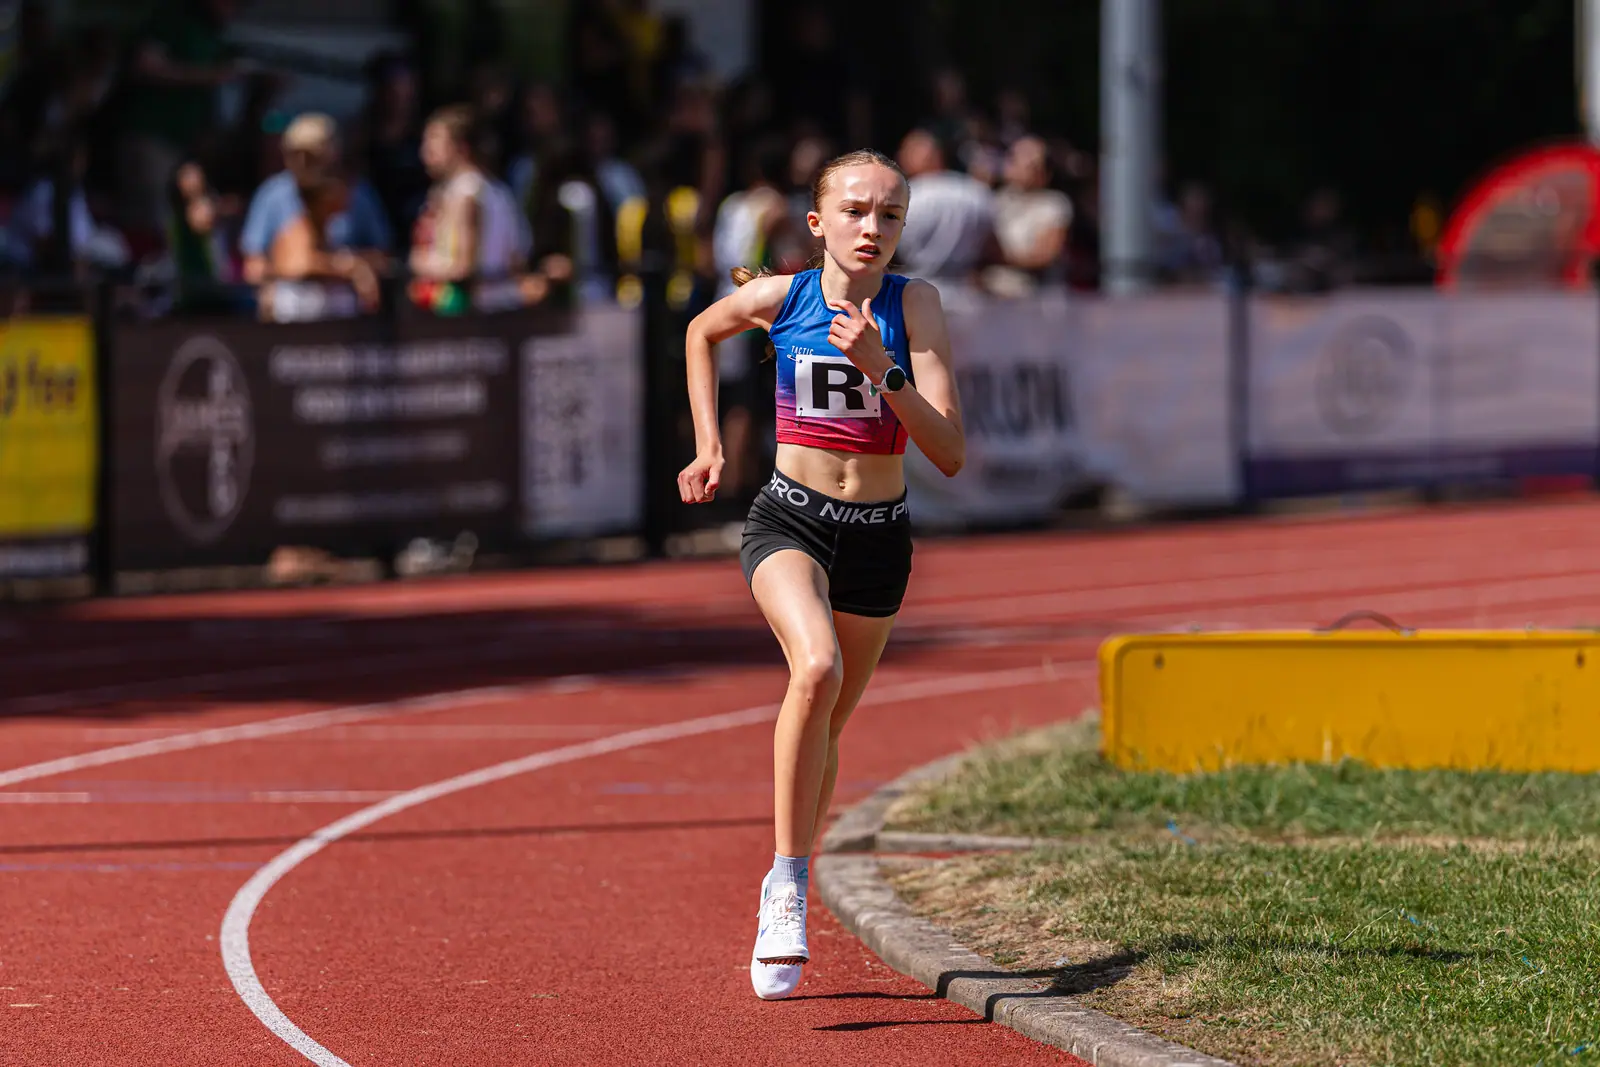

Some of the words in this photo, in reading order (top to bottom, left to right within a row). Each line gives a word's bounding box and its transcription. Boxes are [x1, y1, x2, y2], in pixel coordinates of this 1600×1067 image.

[791, 345, 814, 355] TACTIC
[811, 362, 866, 410] R
[819, 502, 888, 524] NIKE
[892, 501, 908, 521] P
